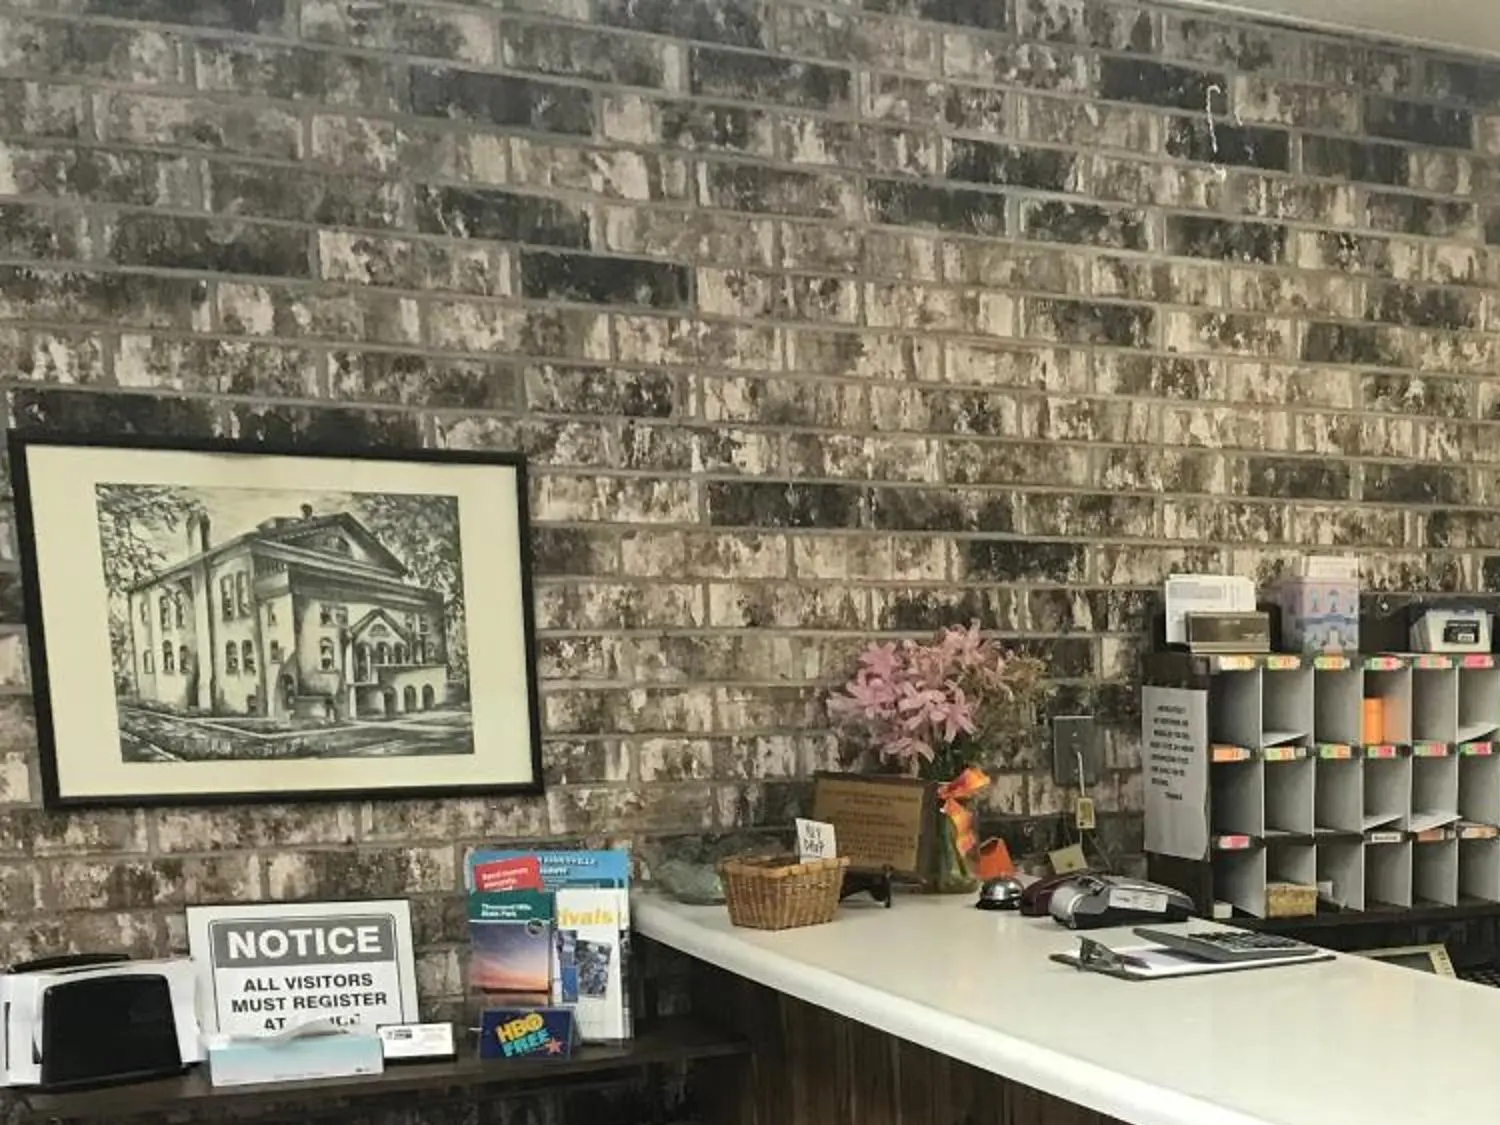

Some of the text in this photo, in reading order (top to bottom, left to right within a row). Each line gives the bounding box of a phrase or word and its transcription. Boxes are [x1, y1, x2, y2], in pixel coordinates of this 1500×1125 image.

[227, 925, 382, 960] NOTICE
[243, 972, 374, 993] ALL VISITORS
[231, 992, 388, 1014] MUST REGISTER
[263, 1017, 287, 1032] AT
[495, 1012, 545, 1043] HBO
[501, 1027, 551, 1058] FREE
